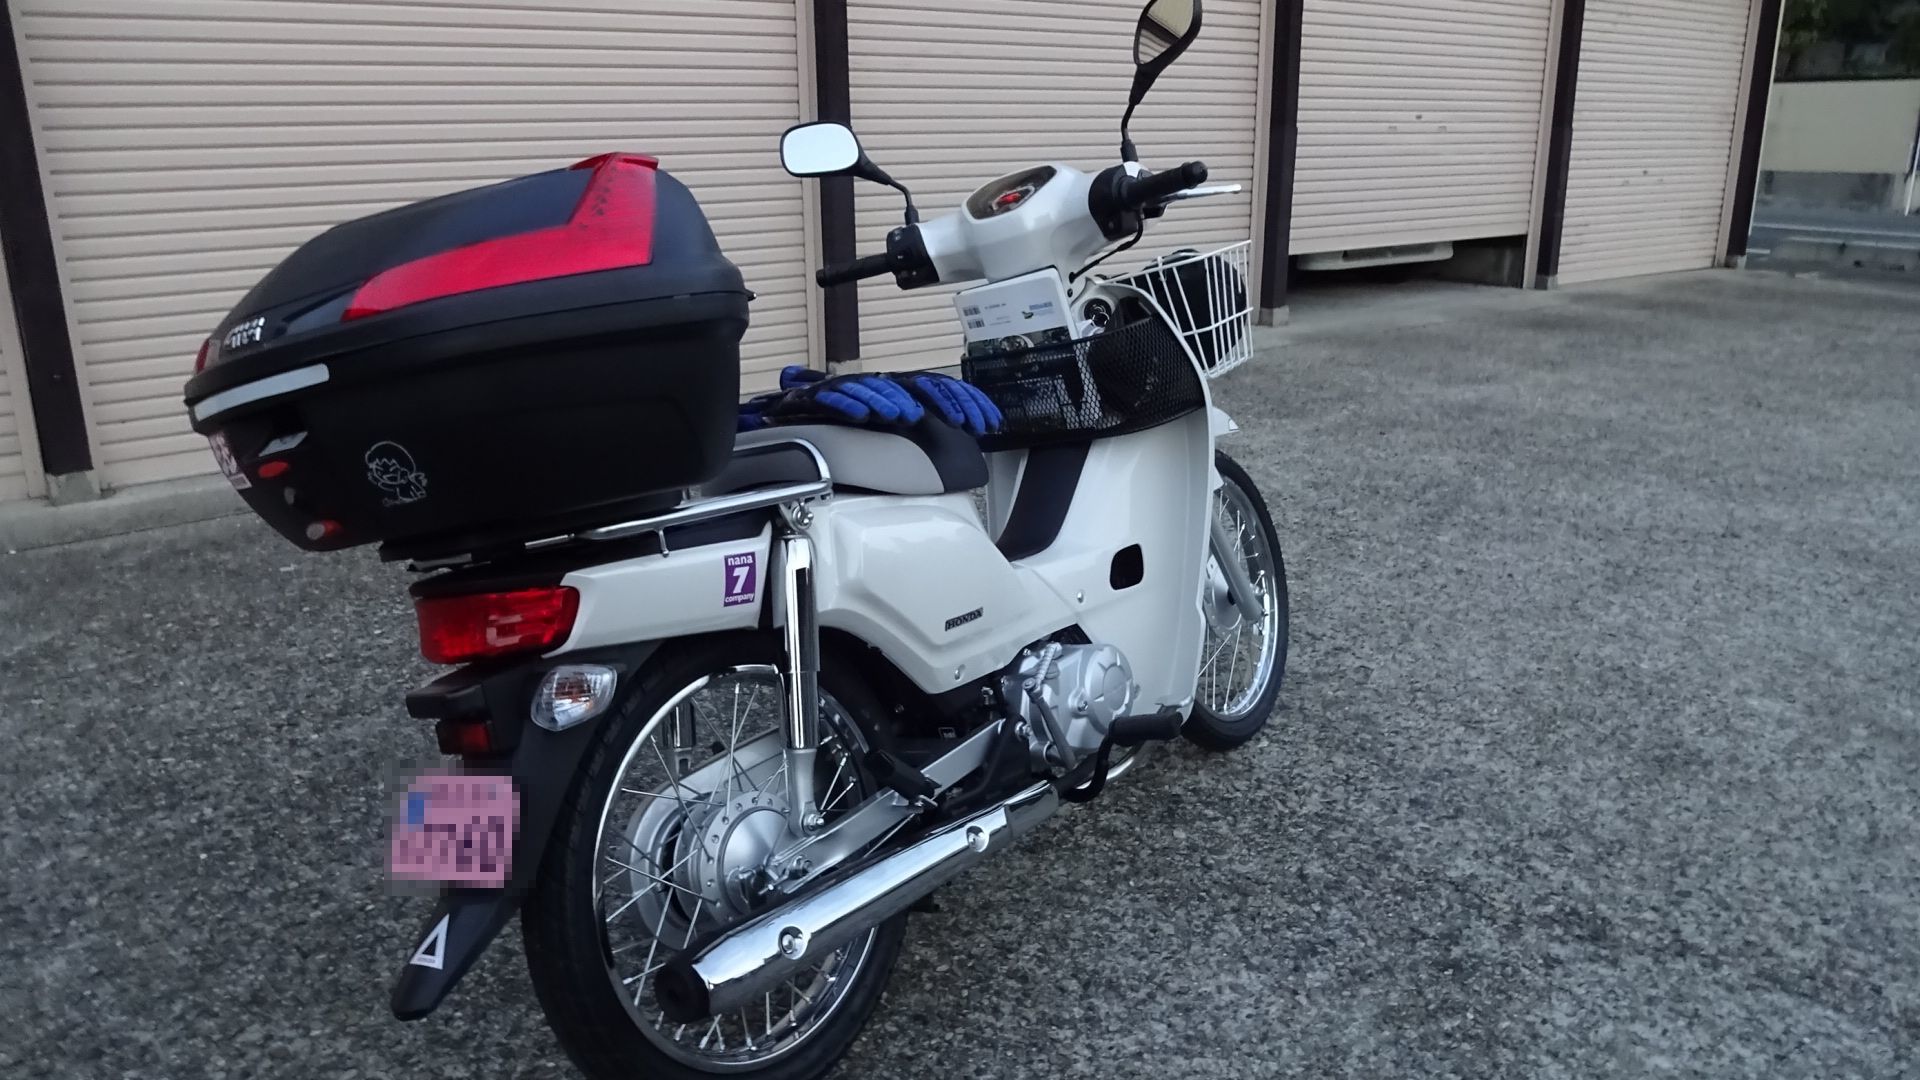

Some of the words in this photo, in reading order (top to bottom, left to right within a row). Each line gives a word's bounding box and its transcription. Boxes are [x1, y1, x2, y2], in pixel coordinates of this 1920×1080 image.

[727, 555, 753, 566] nana
[733, 566, 750, 594] 7
[725, 593, 754, 603] company
[945, 607, 983, 631] HONDA
